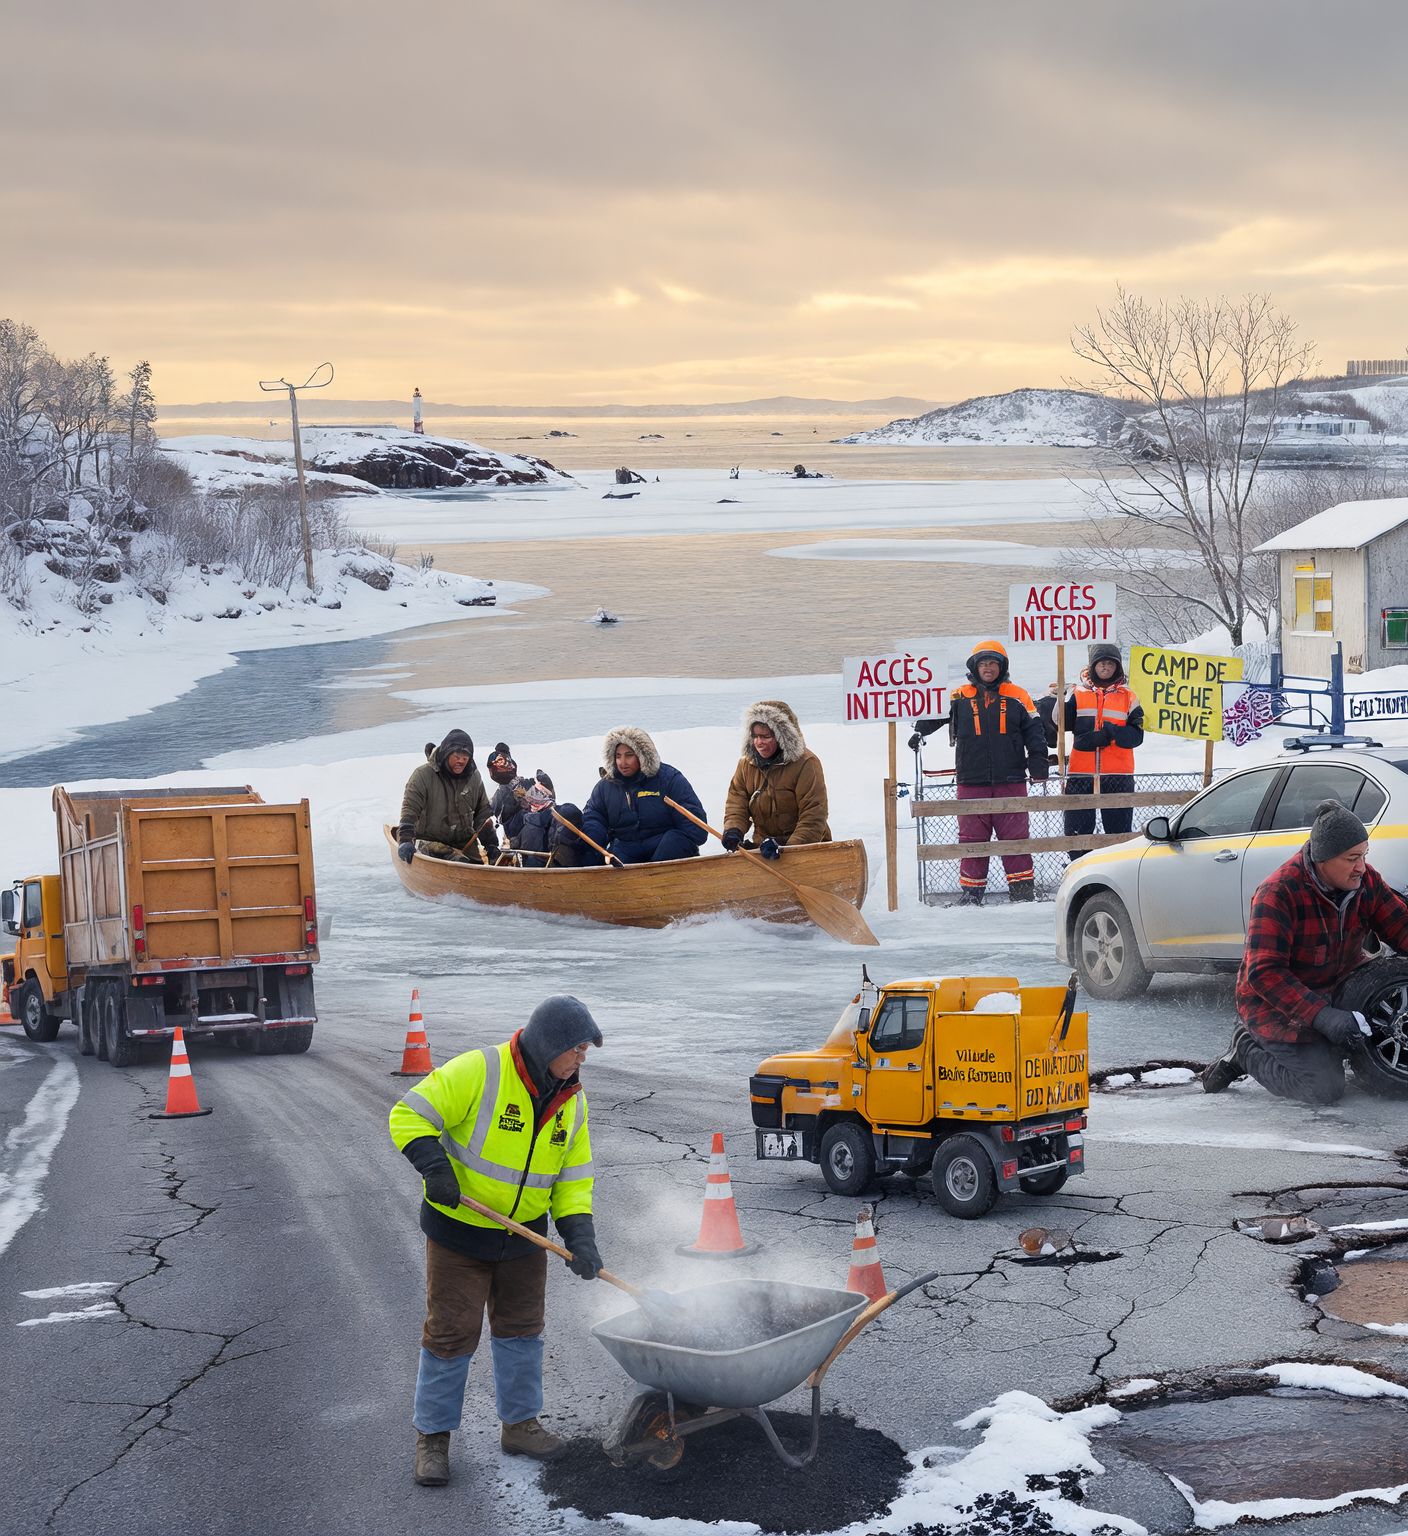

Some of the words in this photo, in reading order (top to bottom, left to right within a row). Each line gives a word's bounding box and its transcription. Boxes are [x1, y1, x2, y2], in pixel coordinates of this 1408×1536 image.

[1025, 581, 1097, 612] ACCÈS
[1013, 613, 1113, 642] INTERDIT
[857, 653, 934, 688] ACCÈS
[1141, 652, 1199, 682] CAMP
[1205, 661, 1228, 684] DE
[846, 687, 947, 721] INTERDIT
[1153, 679, 1214, 709] PÊCHE
[1158, 707, 1212, 737] PRIVÉ
